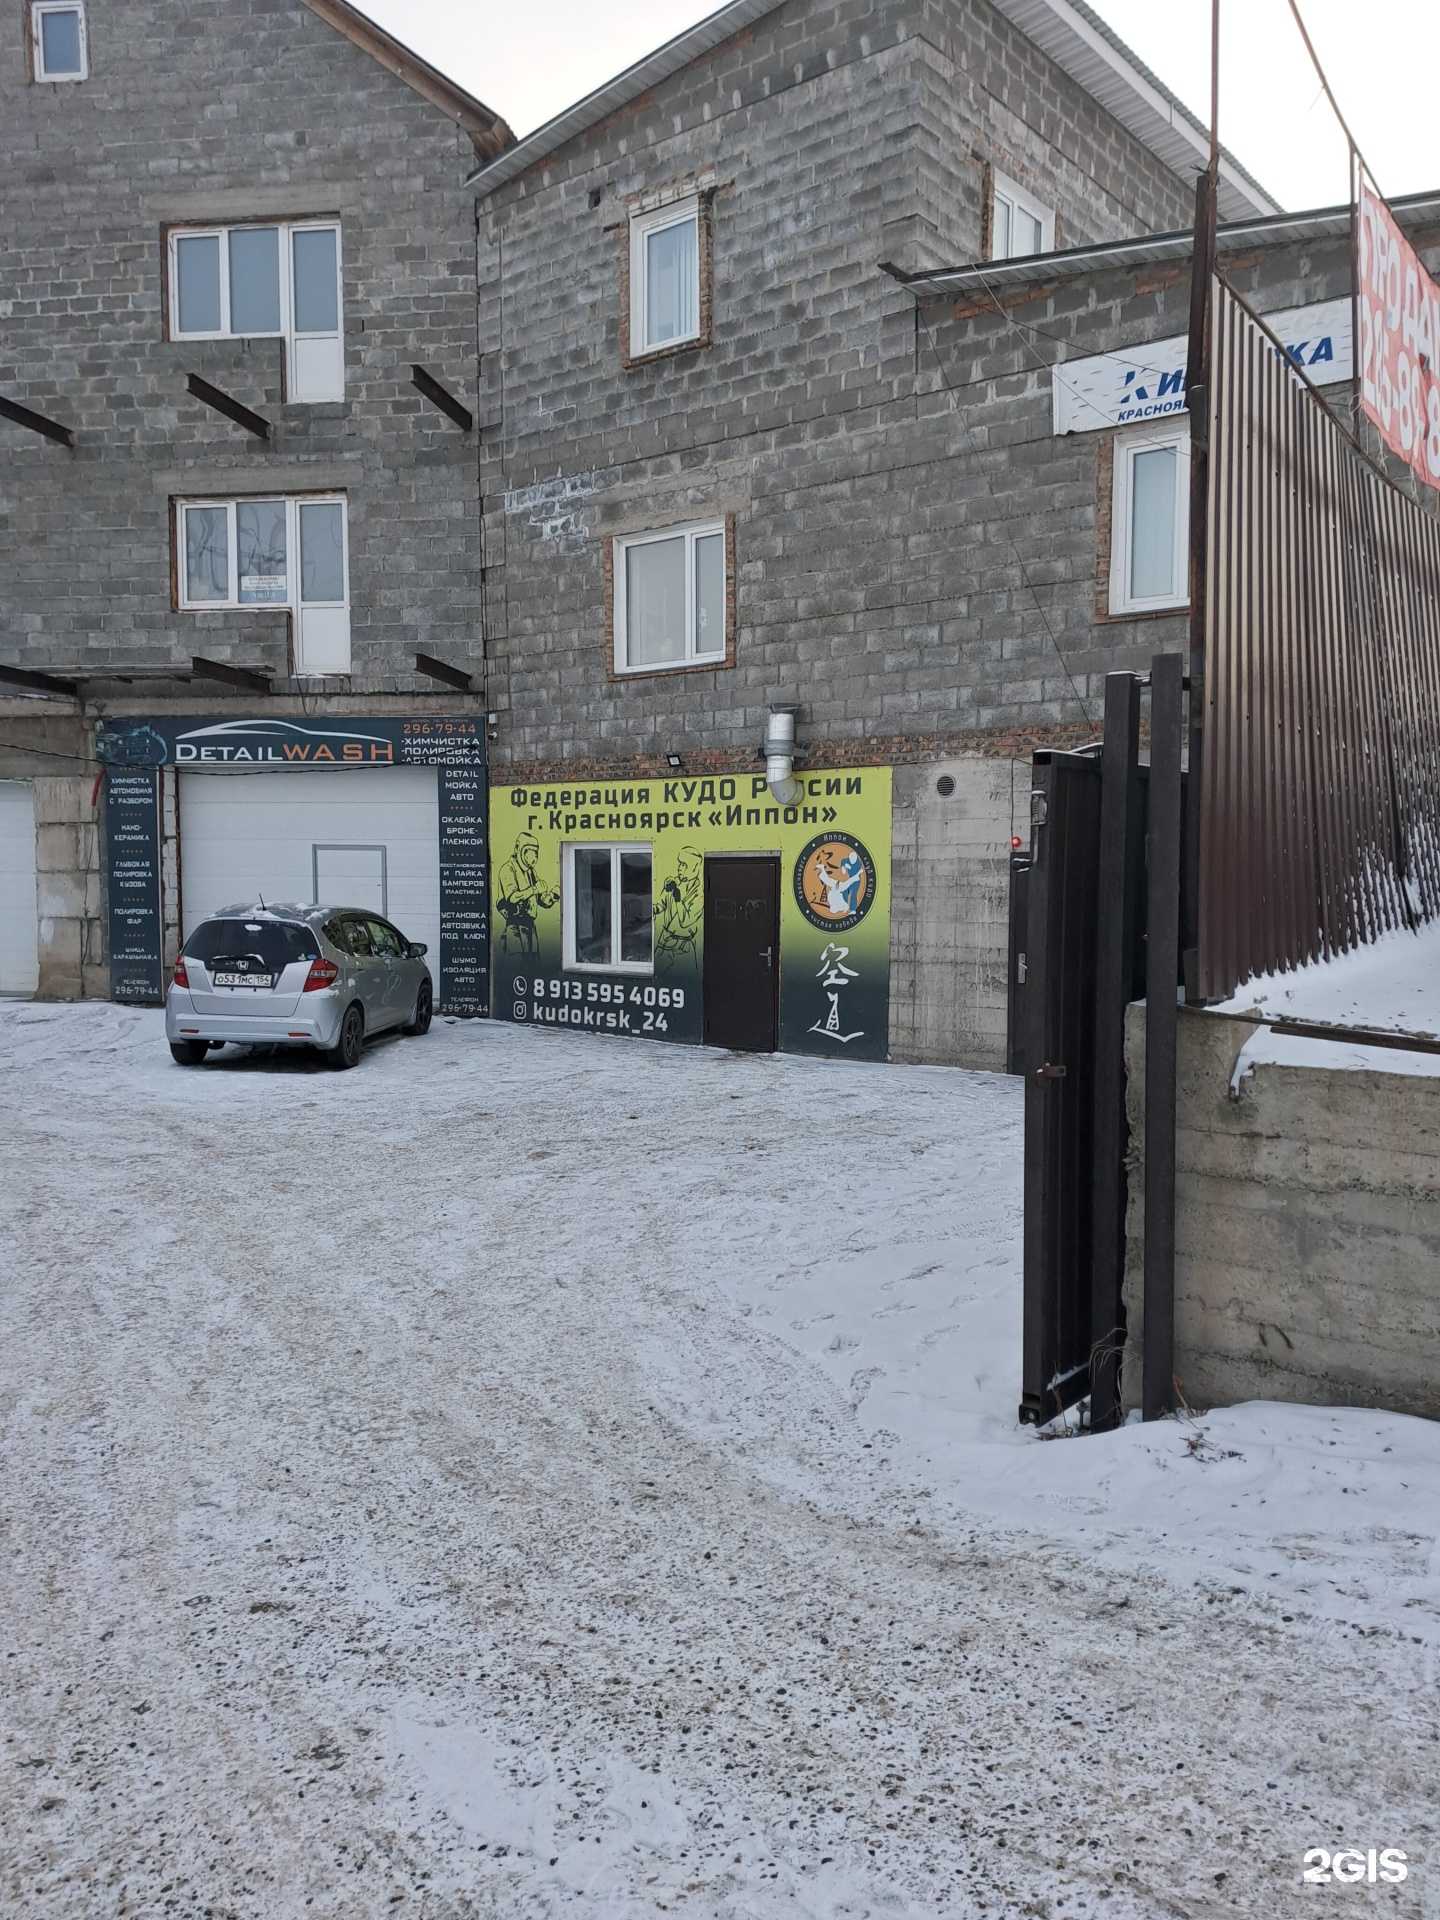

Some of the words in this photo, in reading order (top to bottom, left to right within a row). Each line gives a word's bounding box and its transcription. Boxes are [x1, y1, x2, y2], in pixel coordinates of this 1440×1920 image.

[403, 723, 476, 734] 296-79-44
[445, 770, 479, 778] DETAIL
[445, 781, 478, 789] МОЙКА
[450, 793, 474, 801] АВТО
[510, 787, 650, 809] Федерация
[664, 778, 736, 804] КУДО
[752, 777, 862, 799] Рсии
[441, 815, 482, 823] ОКЛЕЙКА
[442, 837, 484, 846] ПЛЕНКОЙ
[455, 869, 483, 877] ПАЙКА
[441, 911, 487, 919] УСТАНОВКА
[441, 932, 459, 940] ПОД
[463, 932, 486, 940] КЛЮЧ
[533, 978, 545, 997] 8
[550, 979, 583, 1000] 913
[587, 982, 624, 1004] 595
[629, 986, 685, 1008] 4069
